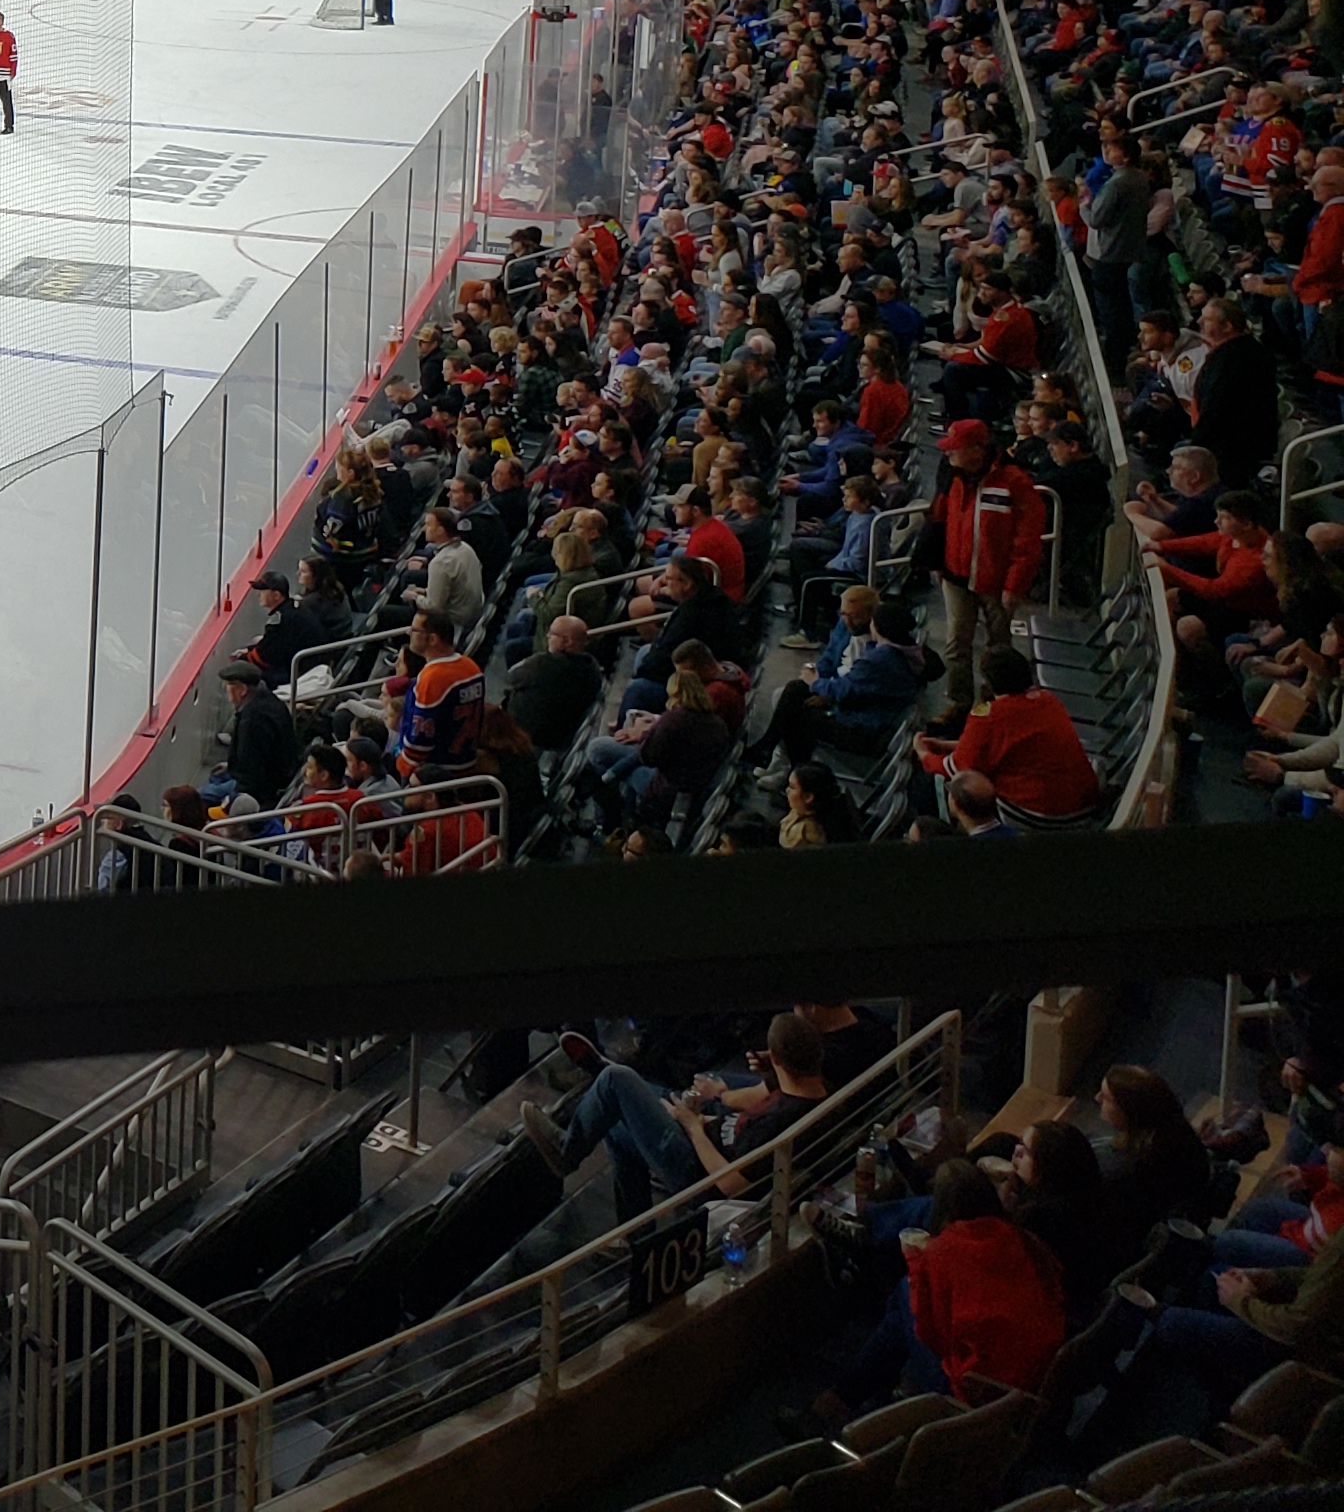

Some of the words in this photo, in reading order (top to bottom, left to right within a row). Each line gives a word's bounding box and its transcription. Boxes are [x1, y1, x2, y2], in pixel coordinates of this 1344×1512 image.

[107, 144, 234, 204] IBEW
[1270, 137, 1289, 151] 19
[642, 1228, 702, 1304] 103
